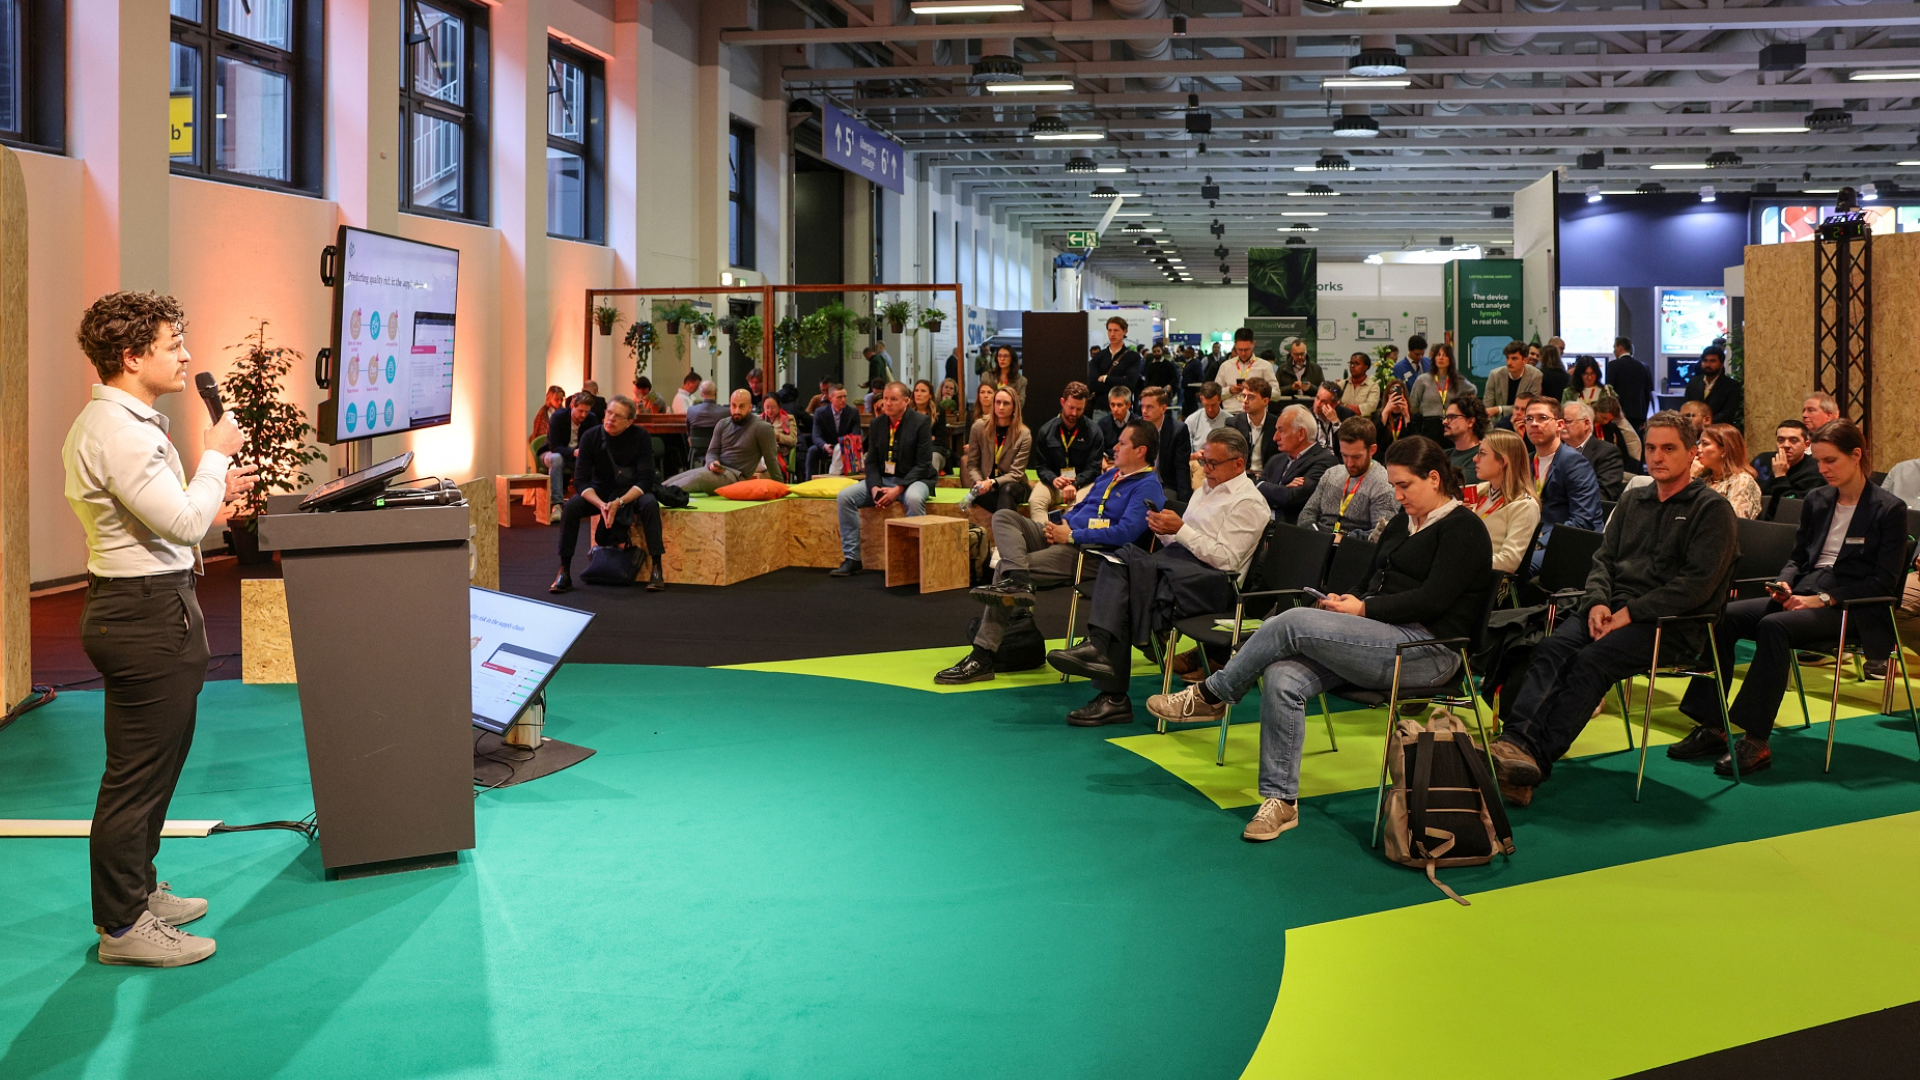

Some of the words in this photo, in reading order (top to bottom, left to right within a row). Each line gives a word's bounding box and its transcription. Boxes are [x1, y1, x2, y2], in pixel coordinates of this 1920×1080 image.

[1316, 281, 1343, 291] orks
[1485, 302, 1511, 310] analyse
[1479, 310, 1502, 318] lymph
